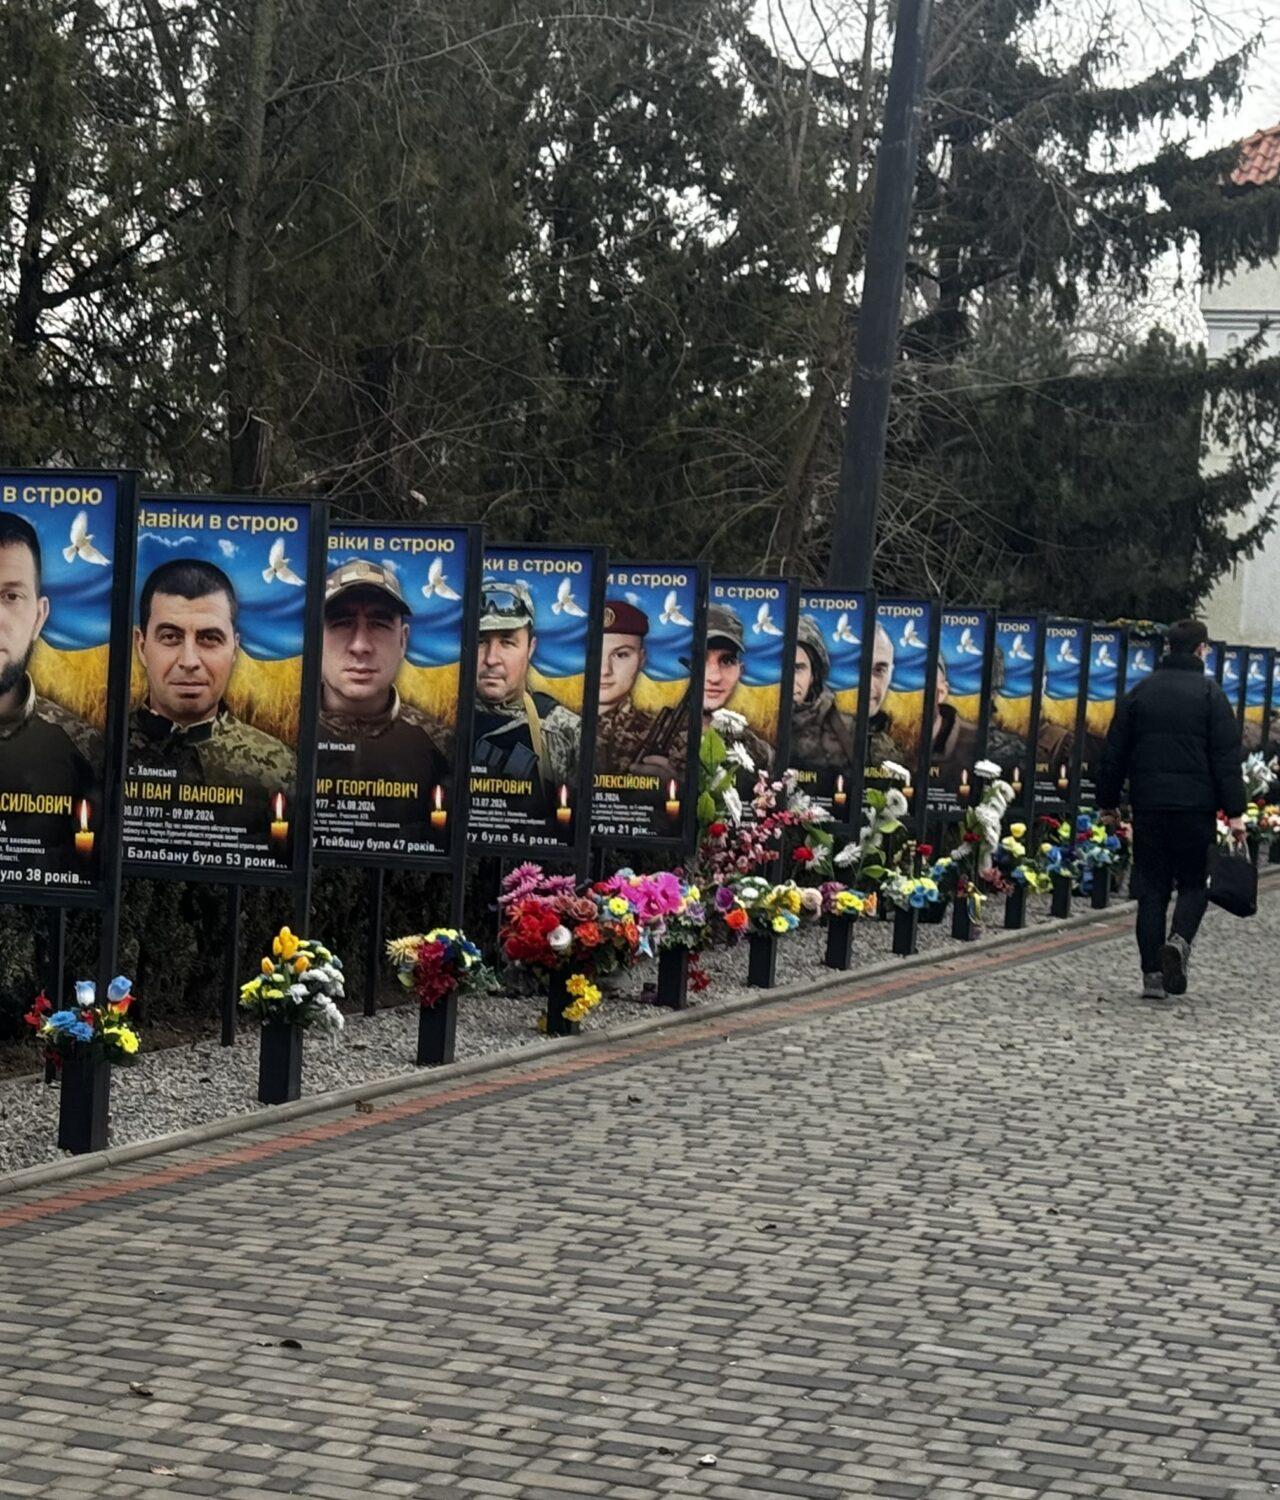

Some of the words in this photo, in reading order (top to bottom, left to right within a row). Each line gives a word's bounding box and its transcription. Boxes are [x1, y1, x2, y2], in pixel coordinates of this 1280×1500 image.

[3, 487, 17, 502] в
[22, 487, 102, 507] строю
[209, 515, 221, 528] в
[227, 515, 299, 534] строю
[328, 532, 369, 550] віки
[373, 538, 385, 550] в
[390, 538, 455, 555] строю
[508, 560, 518, 571] в
[522, 560, 583, 575] строю
[618, 575, 627, 585] в
[631, 573, 687, 588] строю
[714, 587, 724, 597] в
[727, 586, 779, 601] строю
[809, 598, 858, 611] строю
[877, 605, 924, 618] строю
[943, 615, 980, 627] трою
[138, 764, 177, 778] Холмське
[142, 782, 172, 801] ІВАН
[179, 784, 244, 806] ІВАНОВИЧ
[336, 778, 418, 800] ГЕОРГІЙОВИЧ
[172, 808, 215, 822] 09.09.2024
[321, 835, 364, 851] Тейбашу
[366, 838, 391, 851] було
[393, 839, 405, 850] 47
[481, 831, 508, 844] було
[512, 832, 526, 843] 54
[127, 846, 188, 864] Балабану
[193, 849, 222, 867] було
[226, 852, 241, 866] 53
[245, 855, 288, 869] роки...
[25, 868, 41, 882] 38
[45, 870, 91, 885] років...
